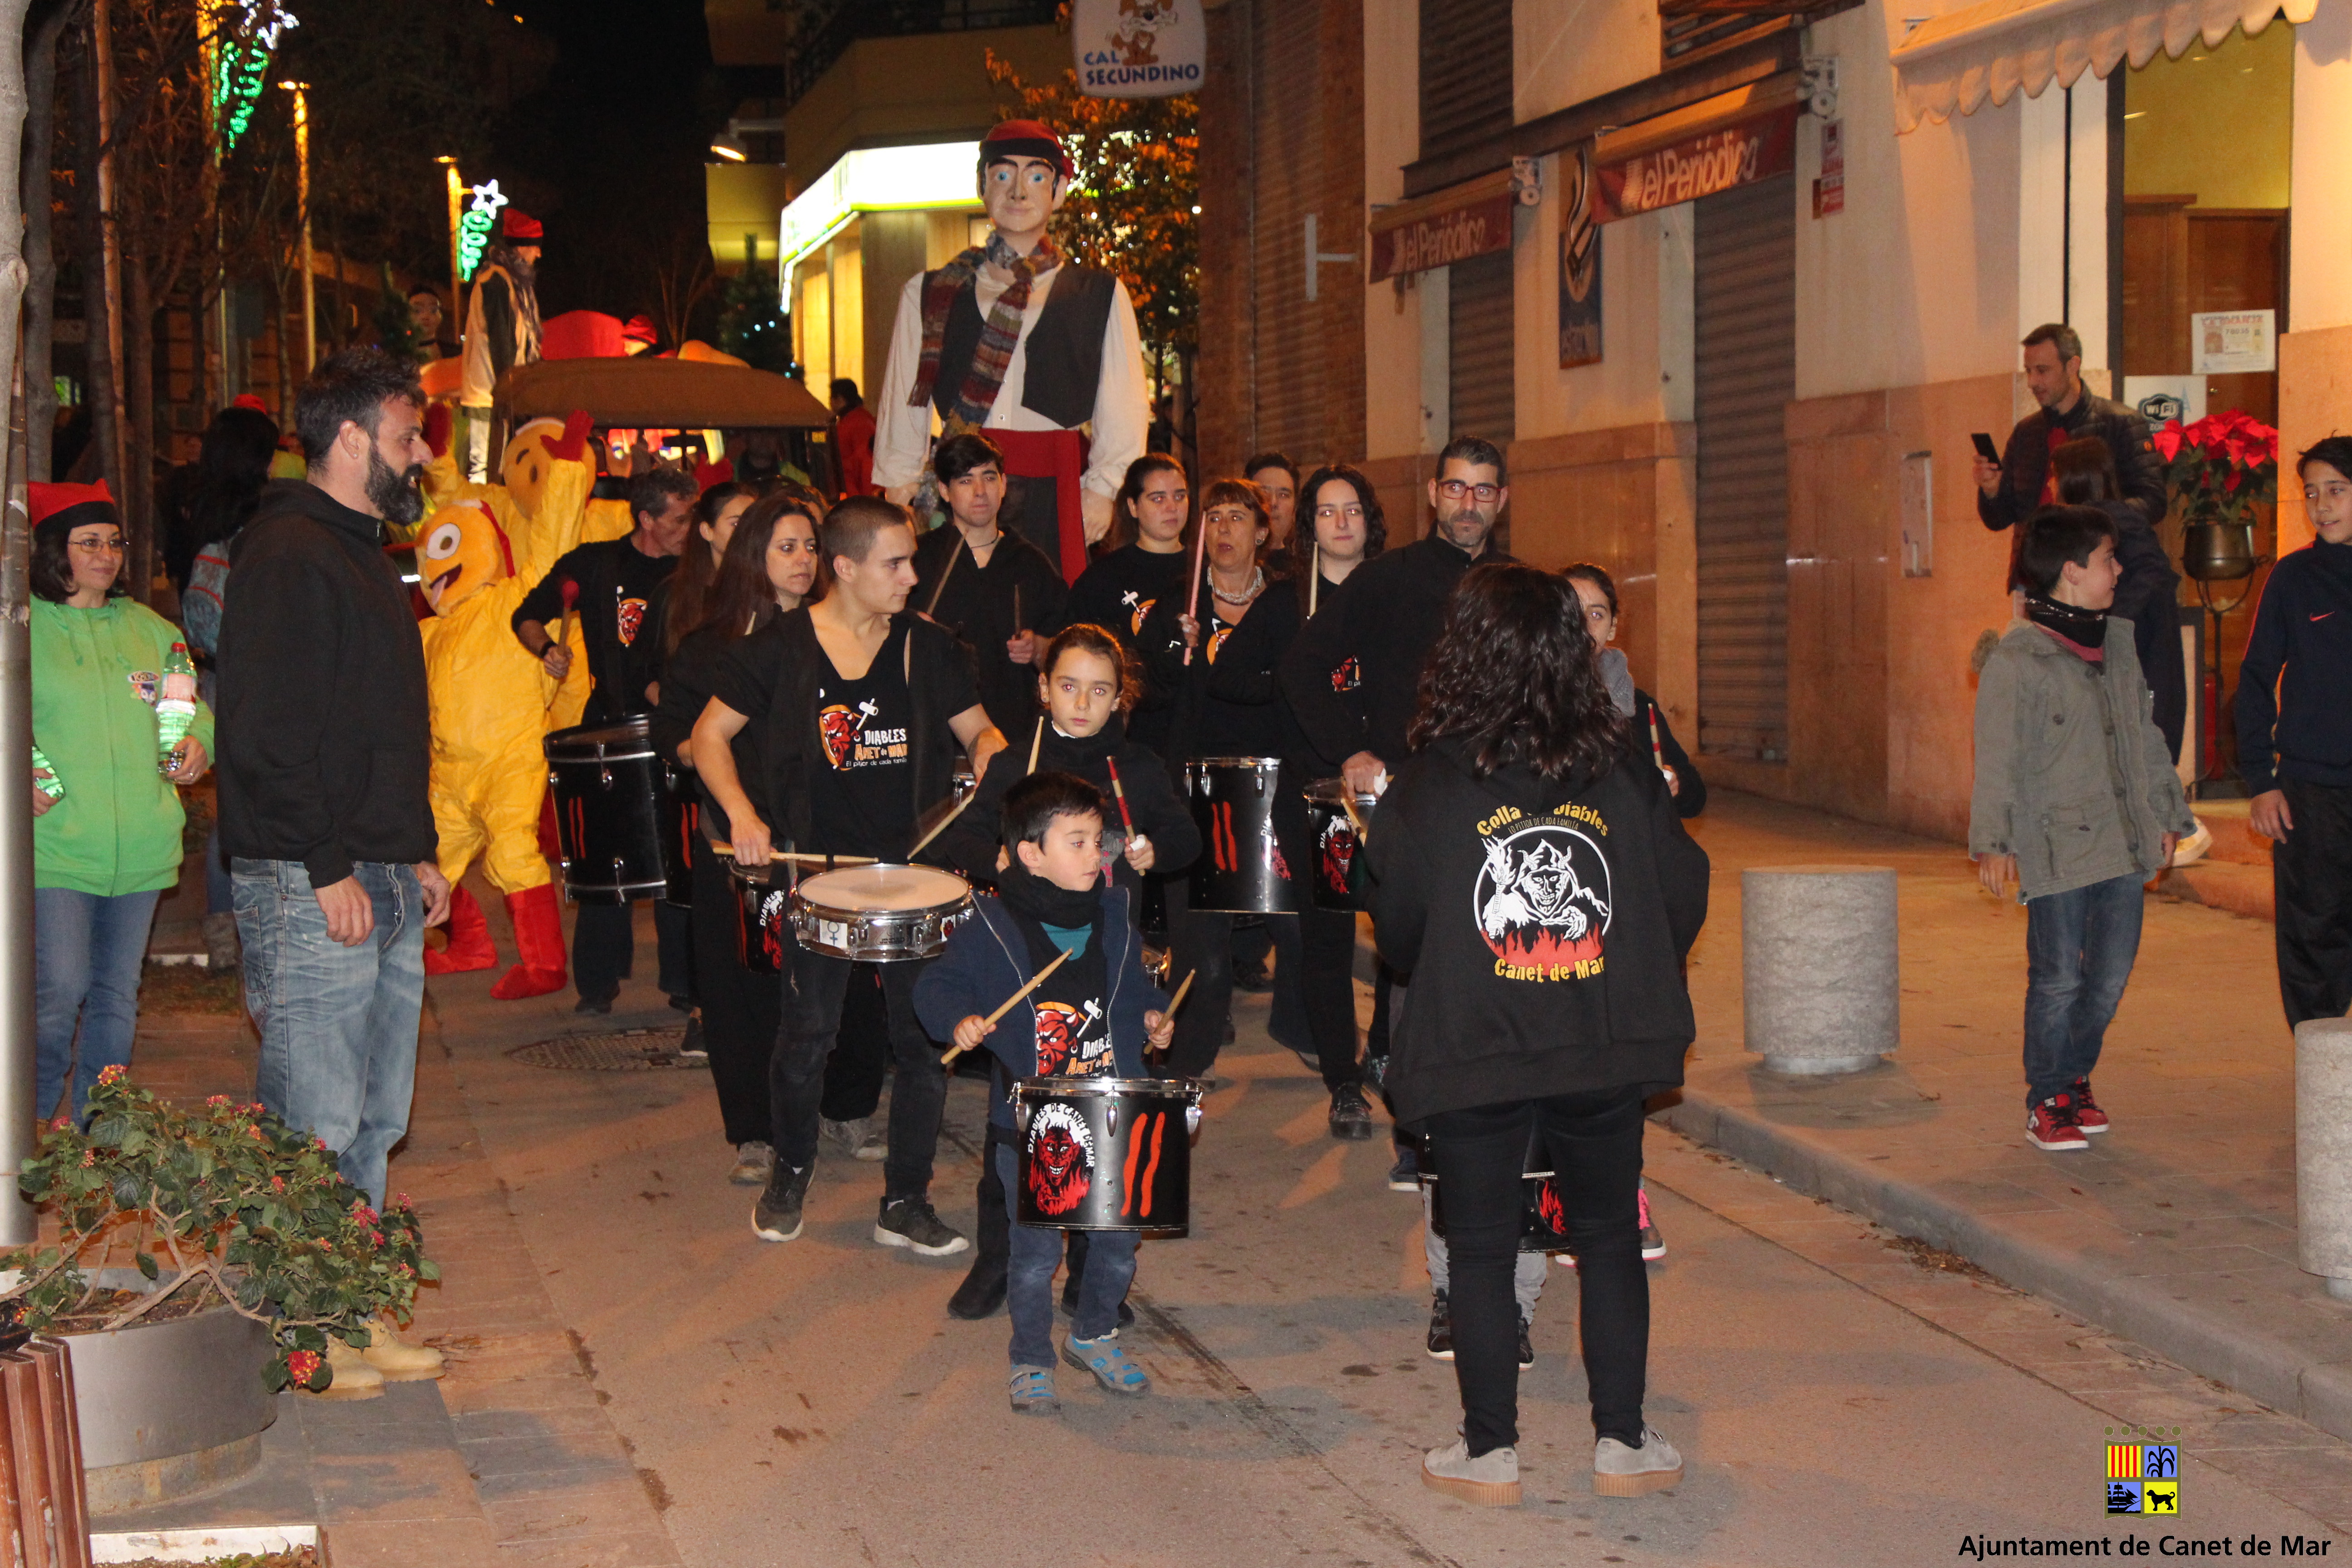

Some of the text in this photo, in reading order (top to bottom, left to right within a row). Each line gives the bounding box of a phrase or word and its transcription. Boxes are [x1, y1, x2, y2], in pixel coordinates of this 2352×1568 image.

[1084, 51, 1119, 65] CAL
[1086, 64, 1199, 85] SECUNDINO
[864, 728, 906, 745] DIABLES
[1477, 805, 1522, 835] Colla
[1541, 817, 1556, 826] CADA
[760, 893, 777, 926] DIABLES
[1494, 956, 1605, 983] Canet de Mar
[1028, 1108, 1047, 1153] DIABLES
[1051, 1102, 1061, 1113] DE
[1063, 1106, 1088, 1132] CANET
[1085, 1146, 1095, 1167] MAR
